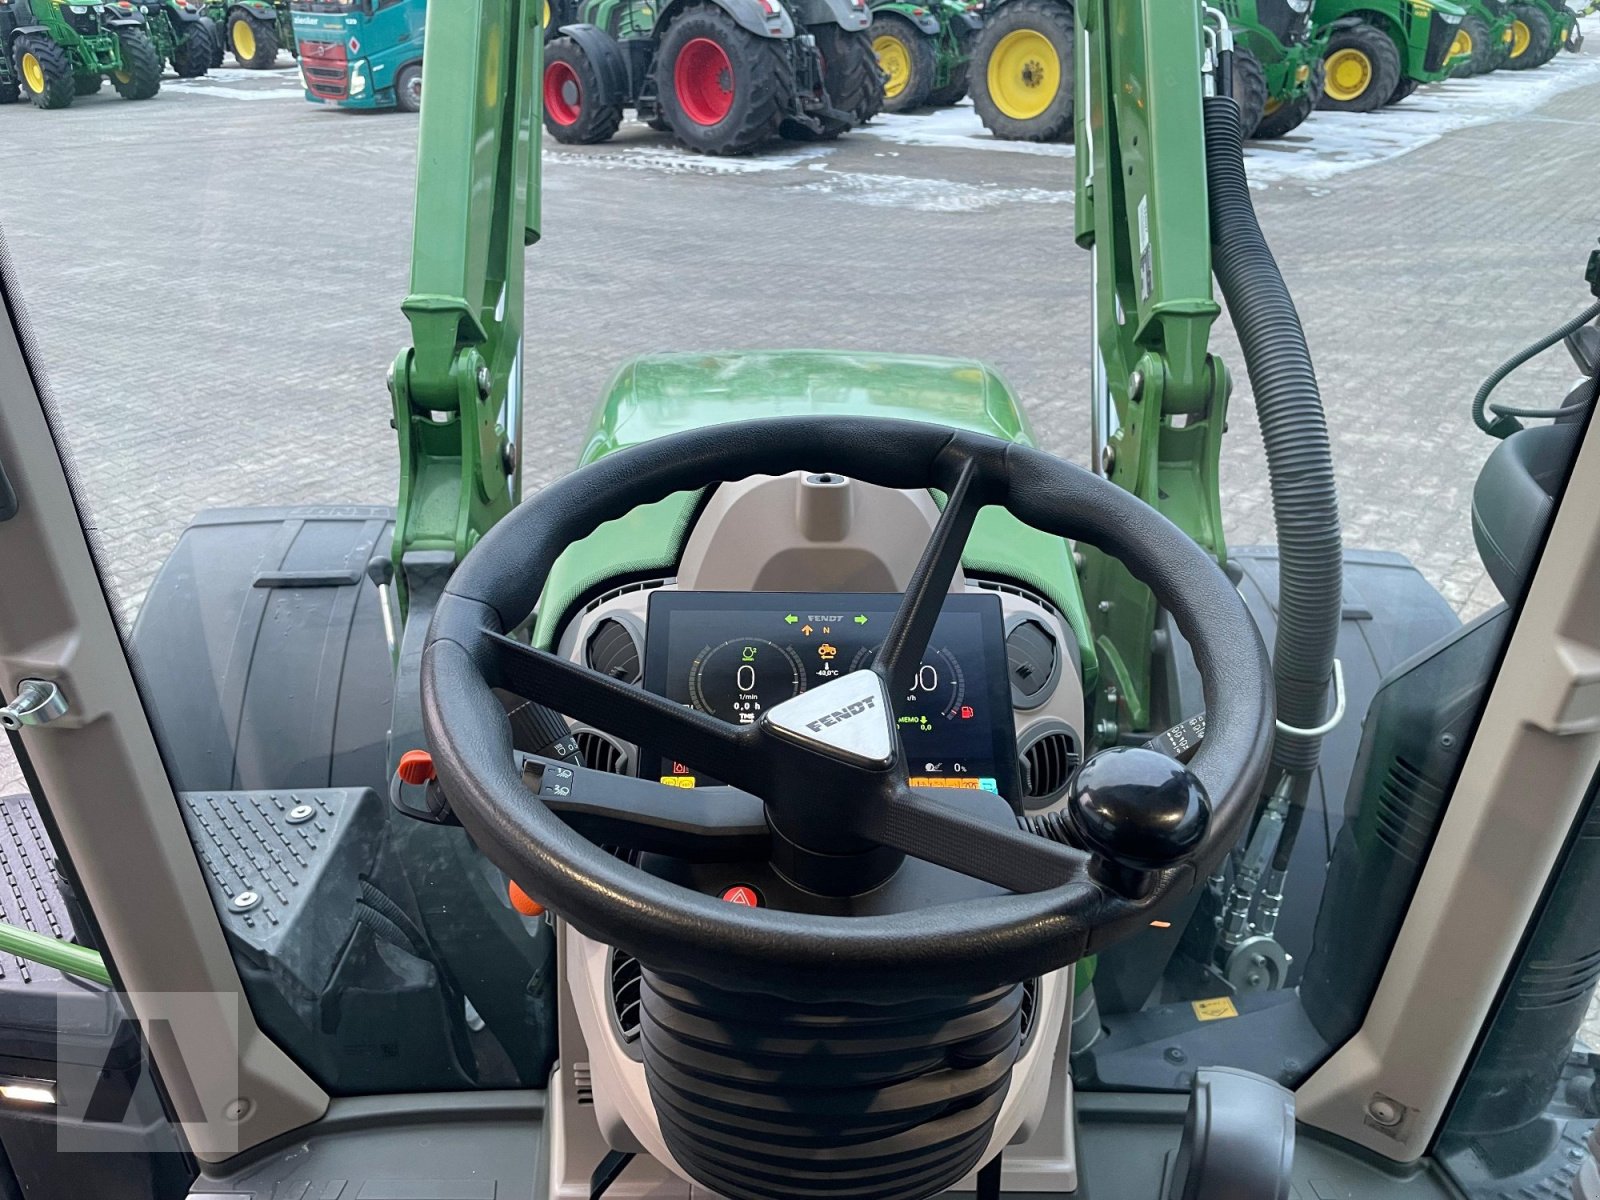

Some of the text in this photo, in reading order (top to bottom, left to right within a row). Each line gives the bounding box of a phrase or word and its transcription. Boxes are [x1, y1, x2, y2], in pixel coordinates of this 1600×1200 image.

[823, 626, 830, 634] N
[737, 665, 755, 691] 0
[754, 702, 761, 710] h
[806, 695, 875, 733] FENDT
